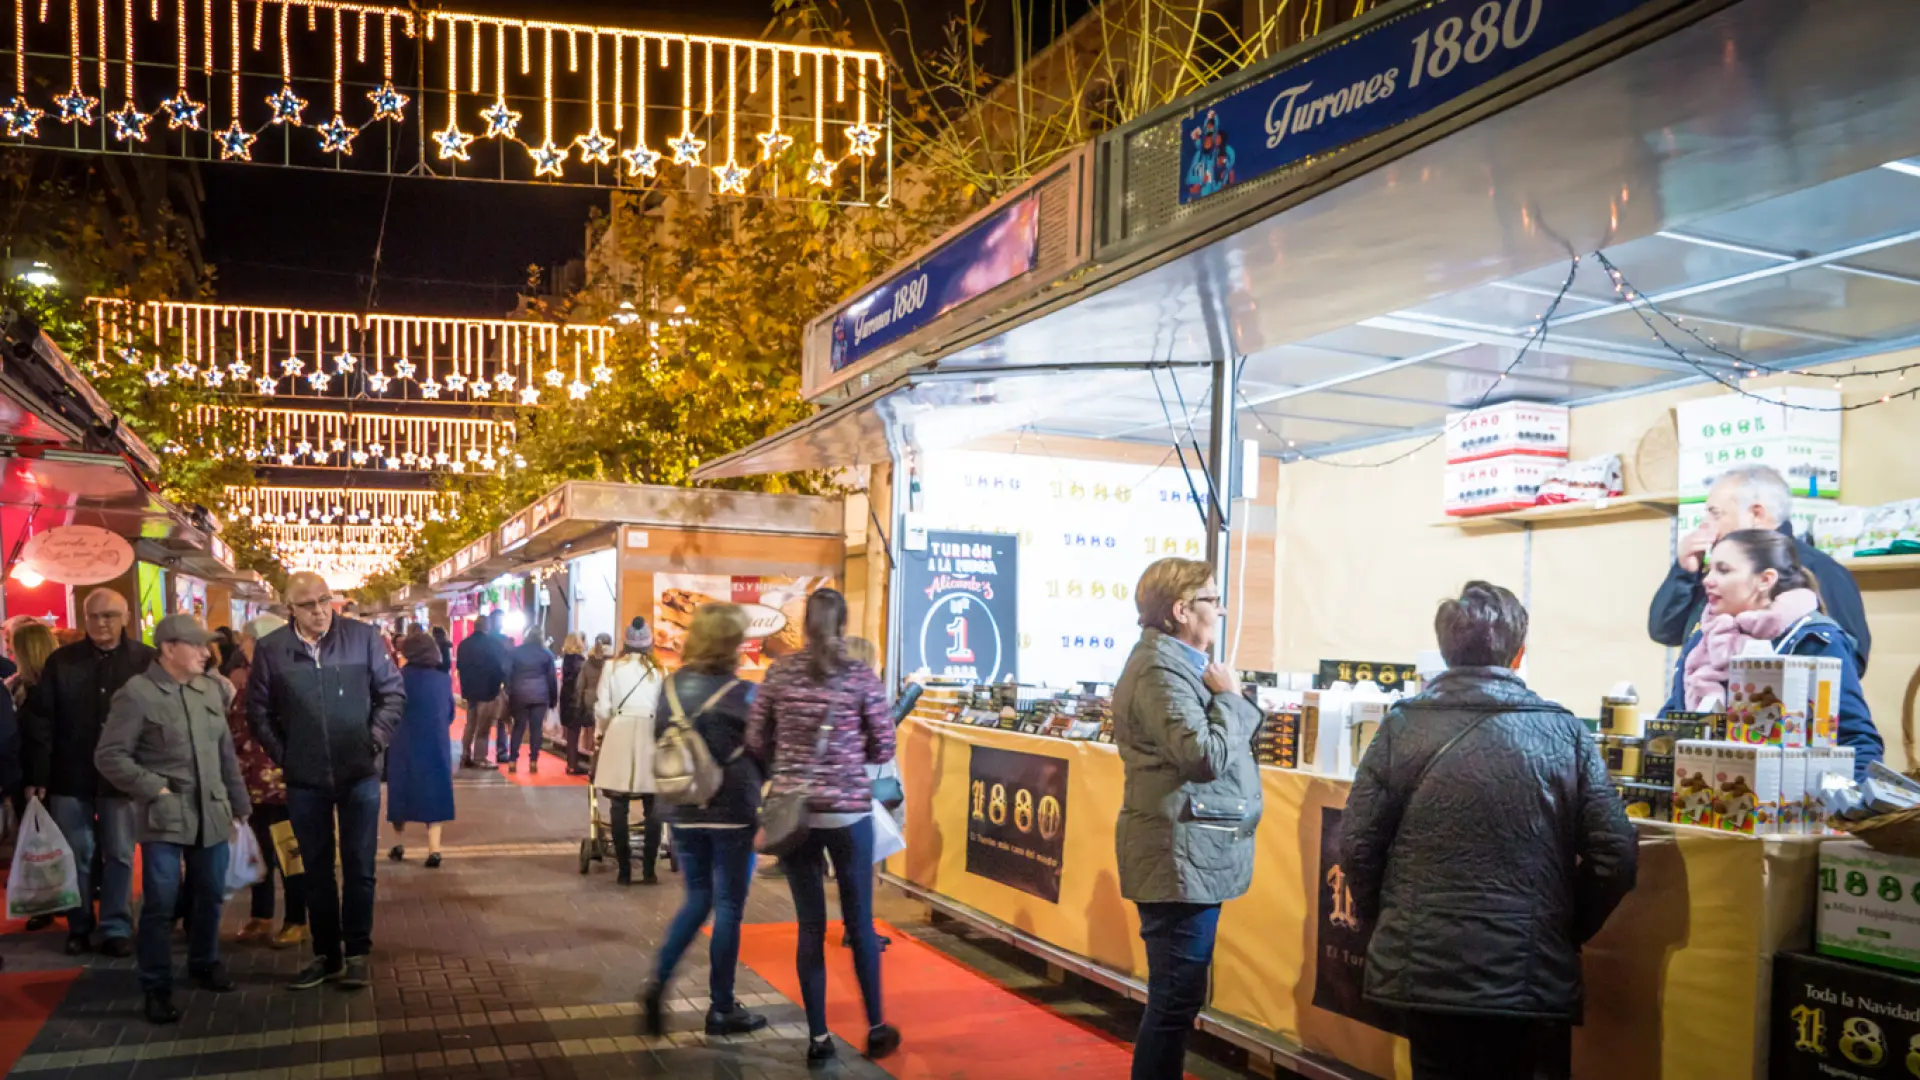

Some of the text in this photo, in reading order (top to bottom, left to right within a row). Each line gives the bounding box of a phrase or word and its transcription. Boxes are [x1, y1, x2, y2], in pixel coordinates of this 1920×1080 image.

[1265, 0, 1543, 149] Turrones 1880
[892, 273, 928, 322] 1880
[1705, 446, 1764, 464] 1880
[1050, 481, 1132, 502] 1880
[1063, 533, 1116, 548] 1880
[1144, 537, 1200, 555] 188
[1046, 579, 1129, 600] 1880
[946, 616, 975, 662] 1
[1062, 635, 1115, 648] 1880
[971, 779, 1060, 840] 1880
[1805, 983, 1920, 1022] Toda la Navidad
